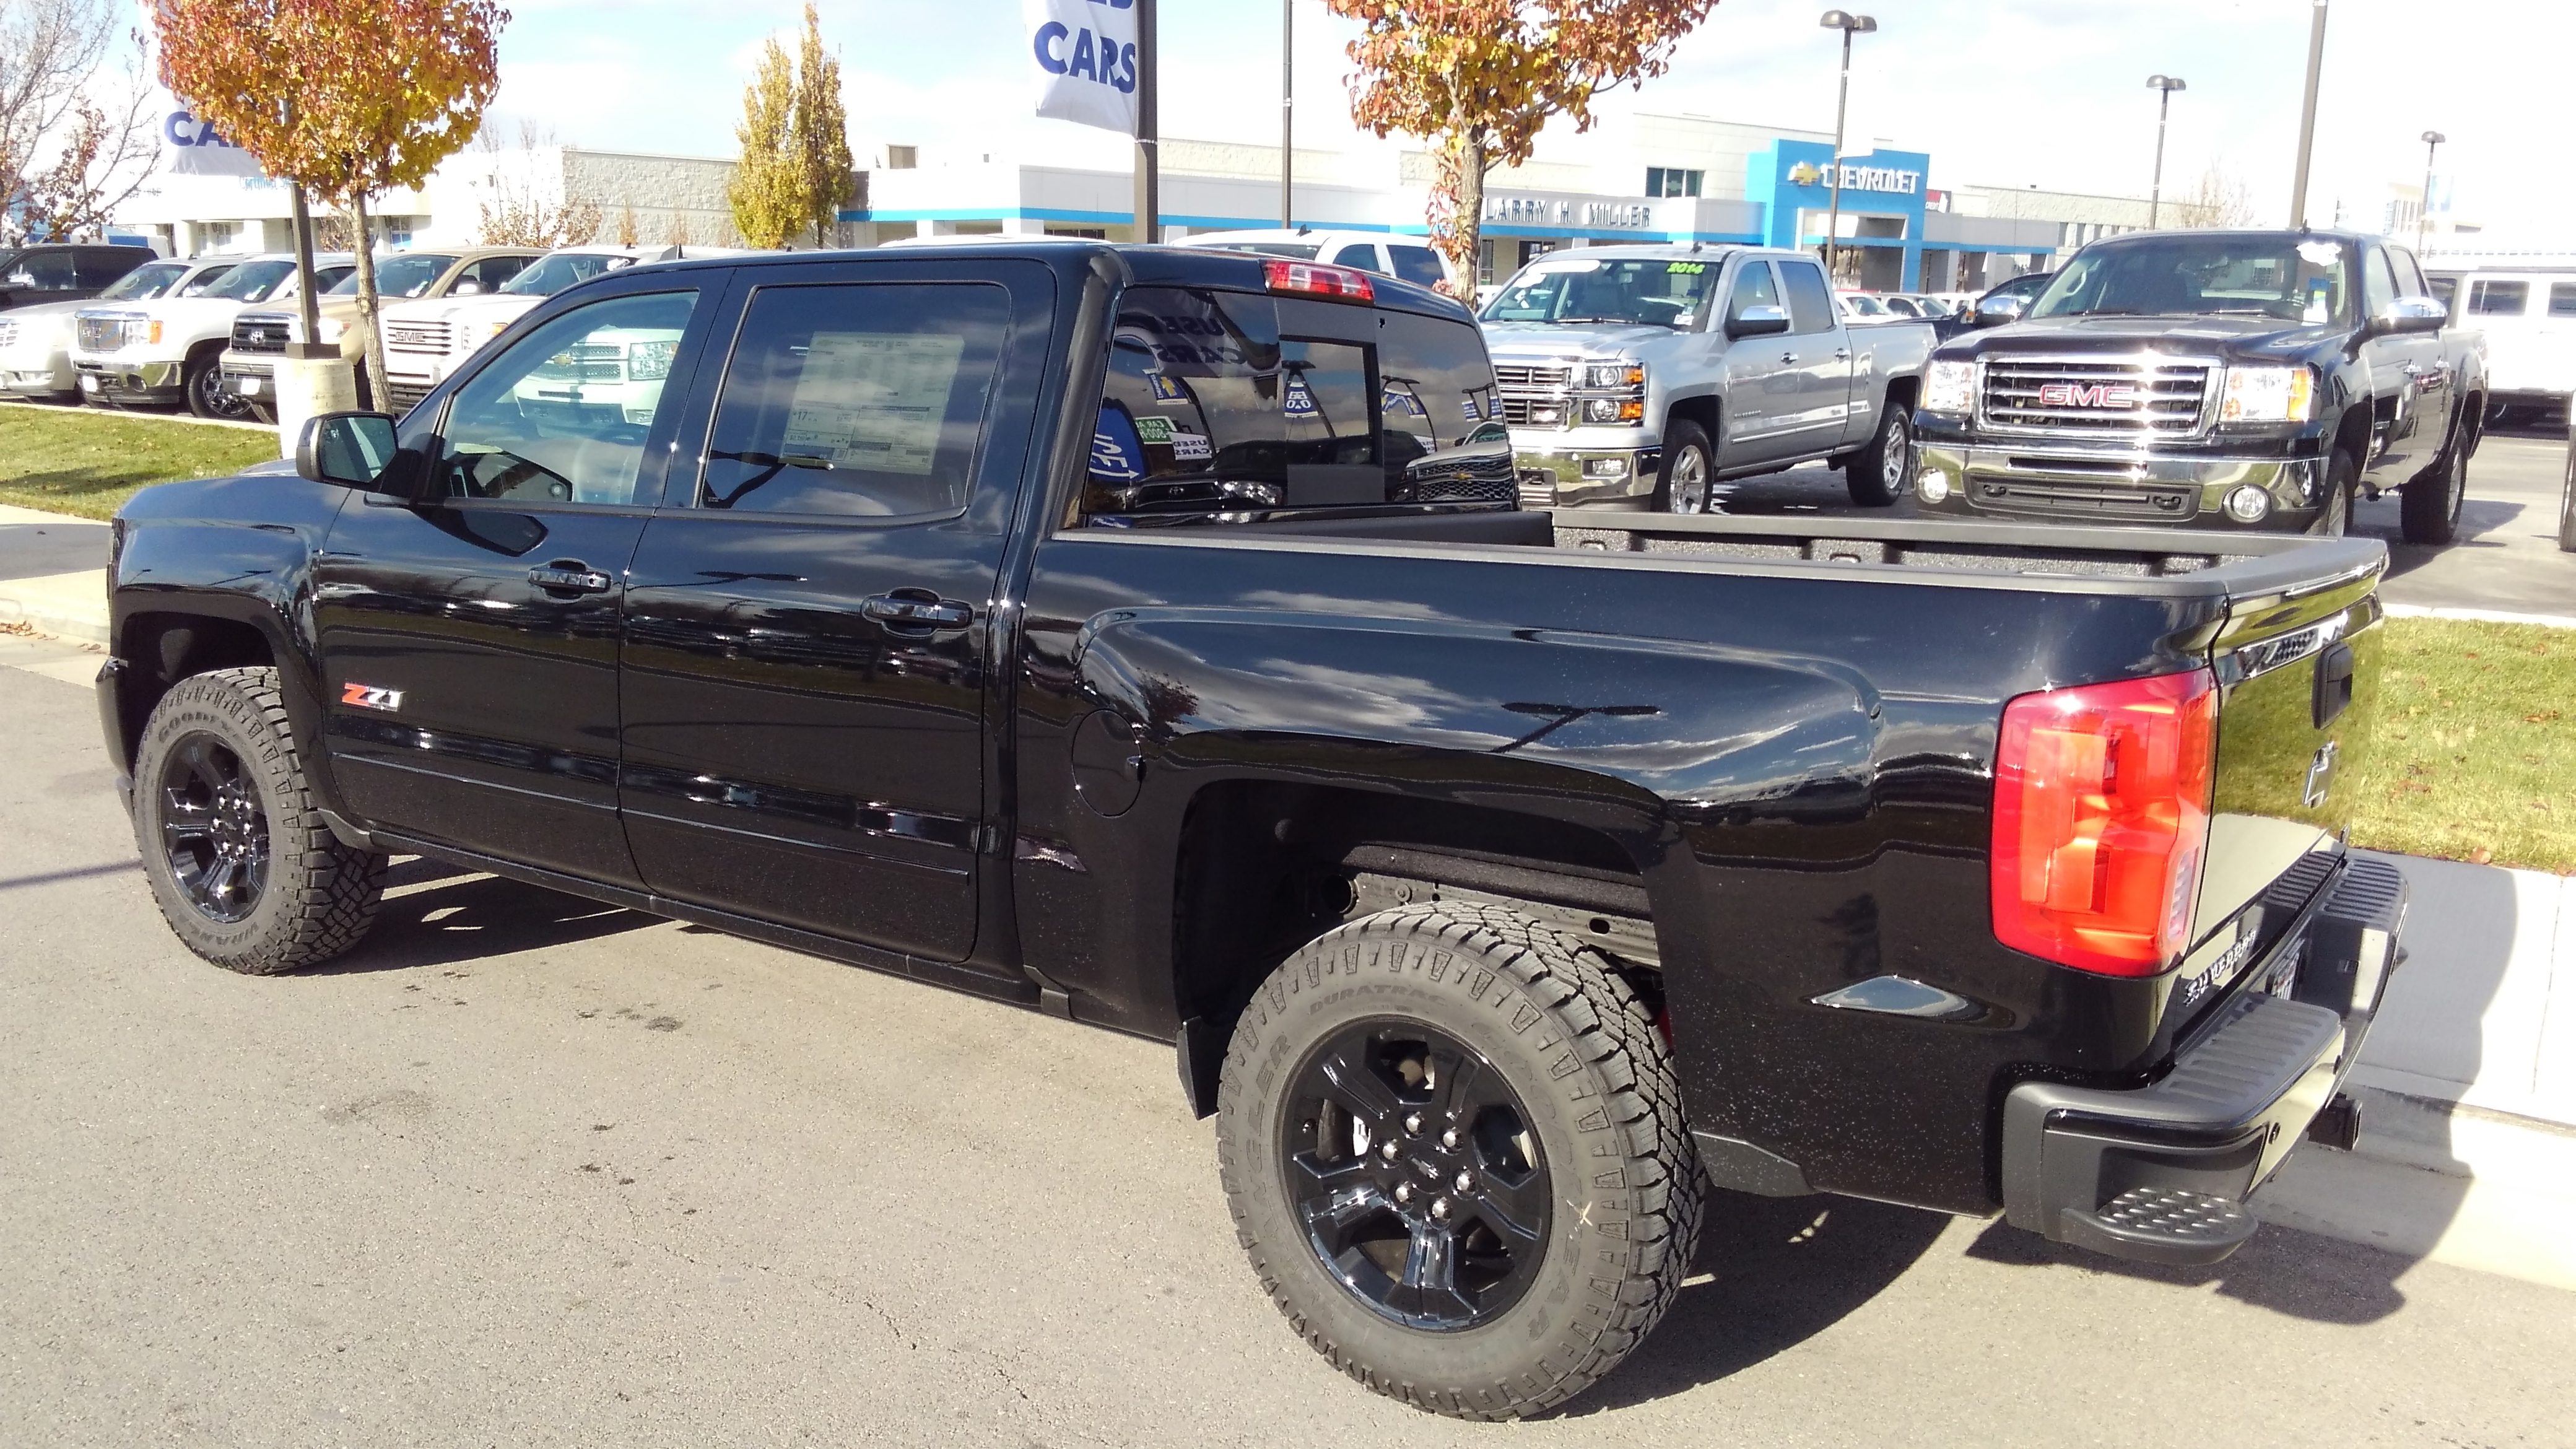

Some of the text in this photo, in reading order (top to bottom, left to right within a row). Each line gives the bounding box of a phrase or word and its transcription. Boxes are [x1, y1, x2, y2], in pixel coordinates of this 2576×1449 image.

[1033, 21, 1136, 94] CARS
[163, 111, 242, 147] CA
[1484, 197, 1651, 227] LARRY H. MILLER
[1666, 262, 1705, 274] 2014
[395, 331, 426, 342] GMC
[2039, 384, 2134, 408] GMC
[342, 682, 403, 712] Z71
[1310, 985, 1449, 1016] DURATRAC
